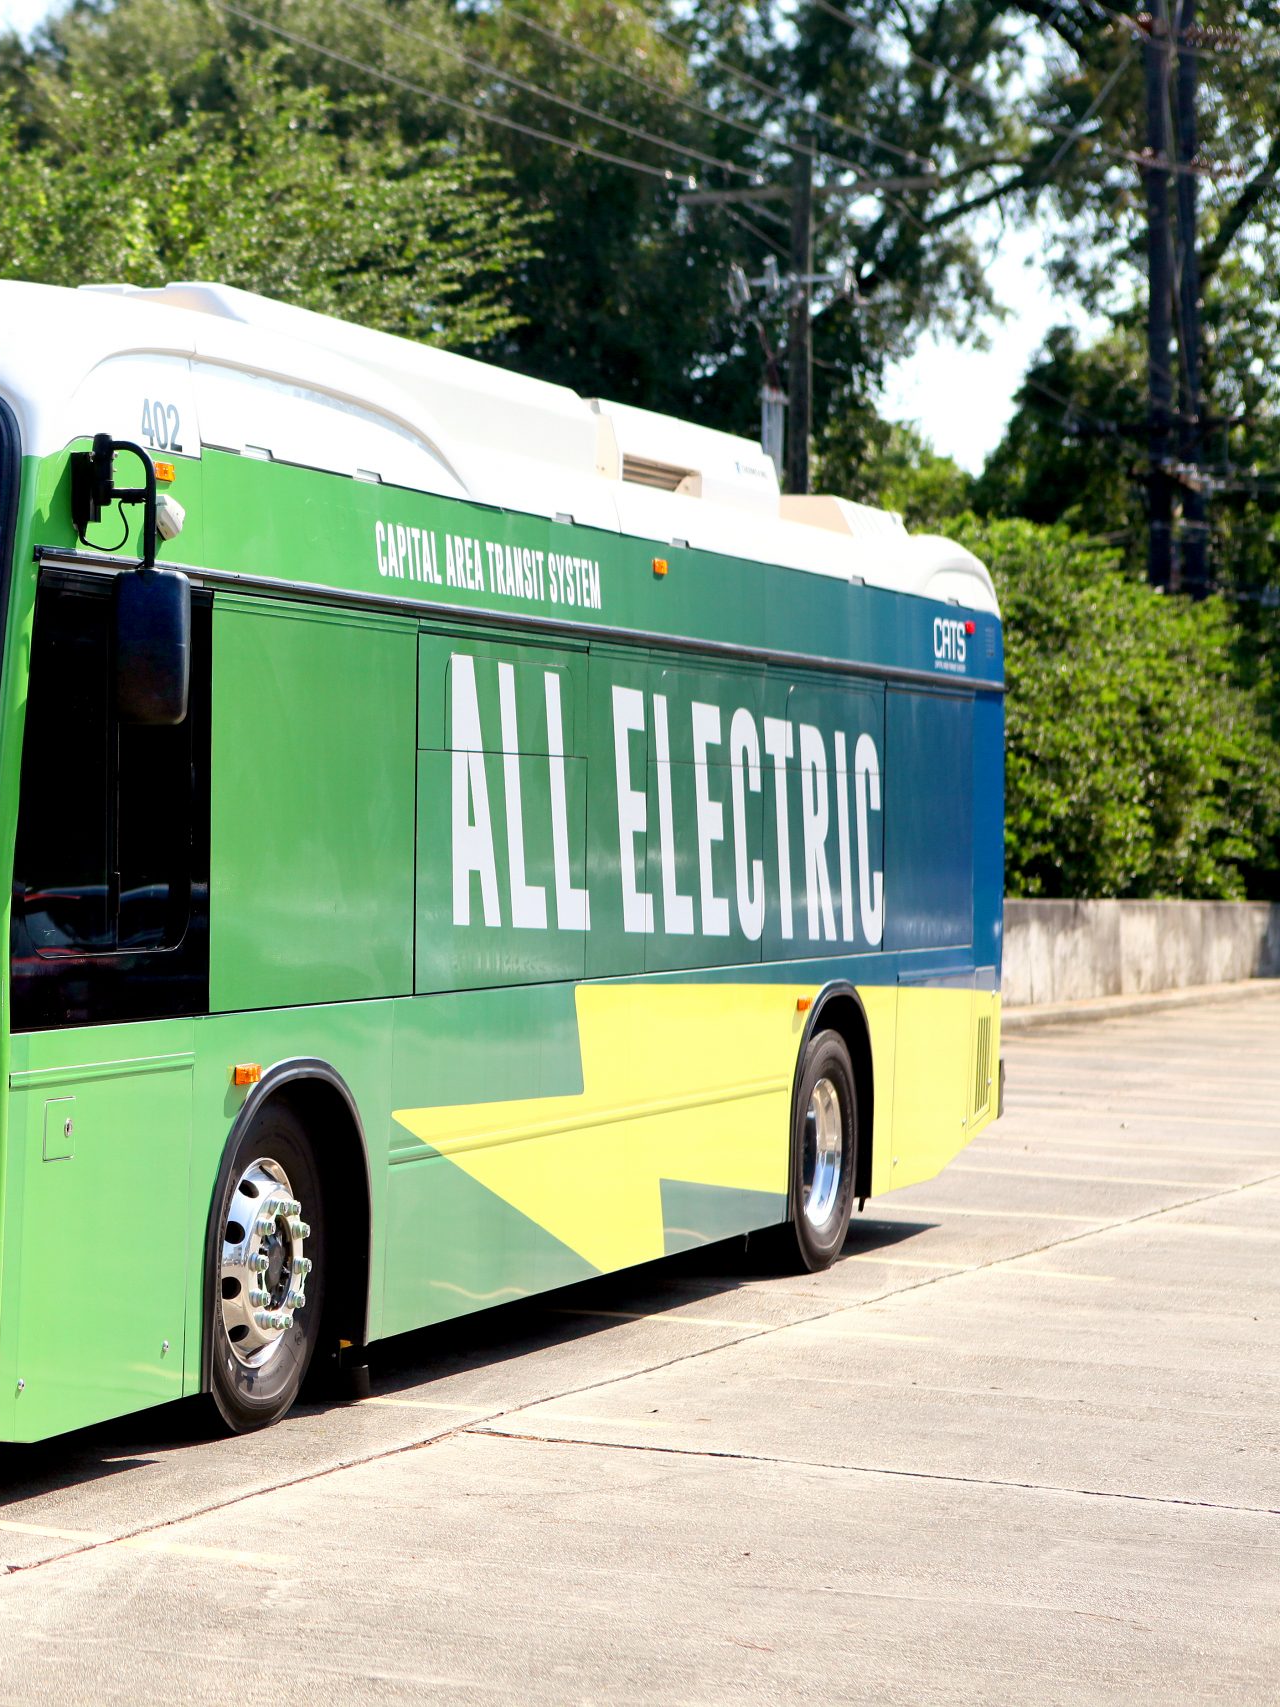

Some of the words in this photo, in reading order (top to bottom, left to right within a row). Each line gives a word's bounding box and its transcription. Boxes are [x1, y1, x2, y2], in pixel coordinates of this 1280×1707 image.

[141, 398, 183, 453] 402
[375, 520, 443, 586] CAPITAL
[445, 533, 485, 592] AREA
[485, 541, 546, 601] TRANSIT
[547, 552, 602, 610] SYSTEM
[933, 616, 967, 663] CATS
[450, 654, 591, 931] ALL
[611, 685, 885, 946] ELECTRIC
